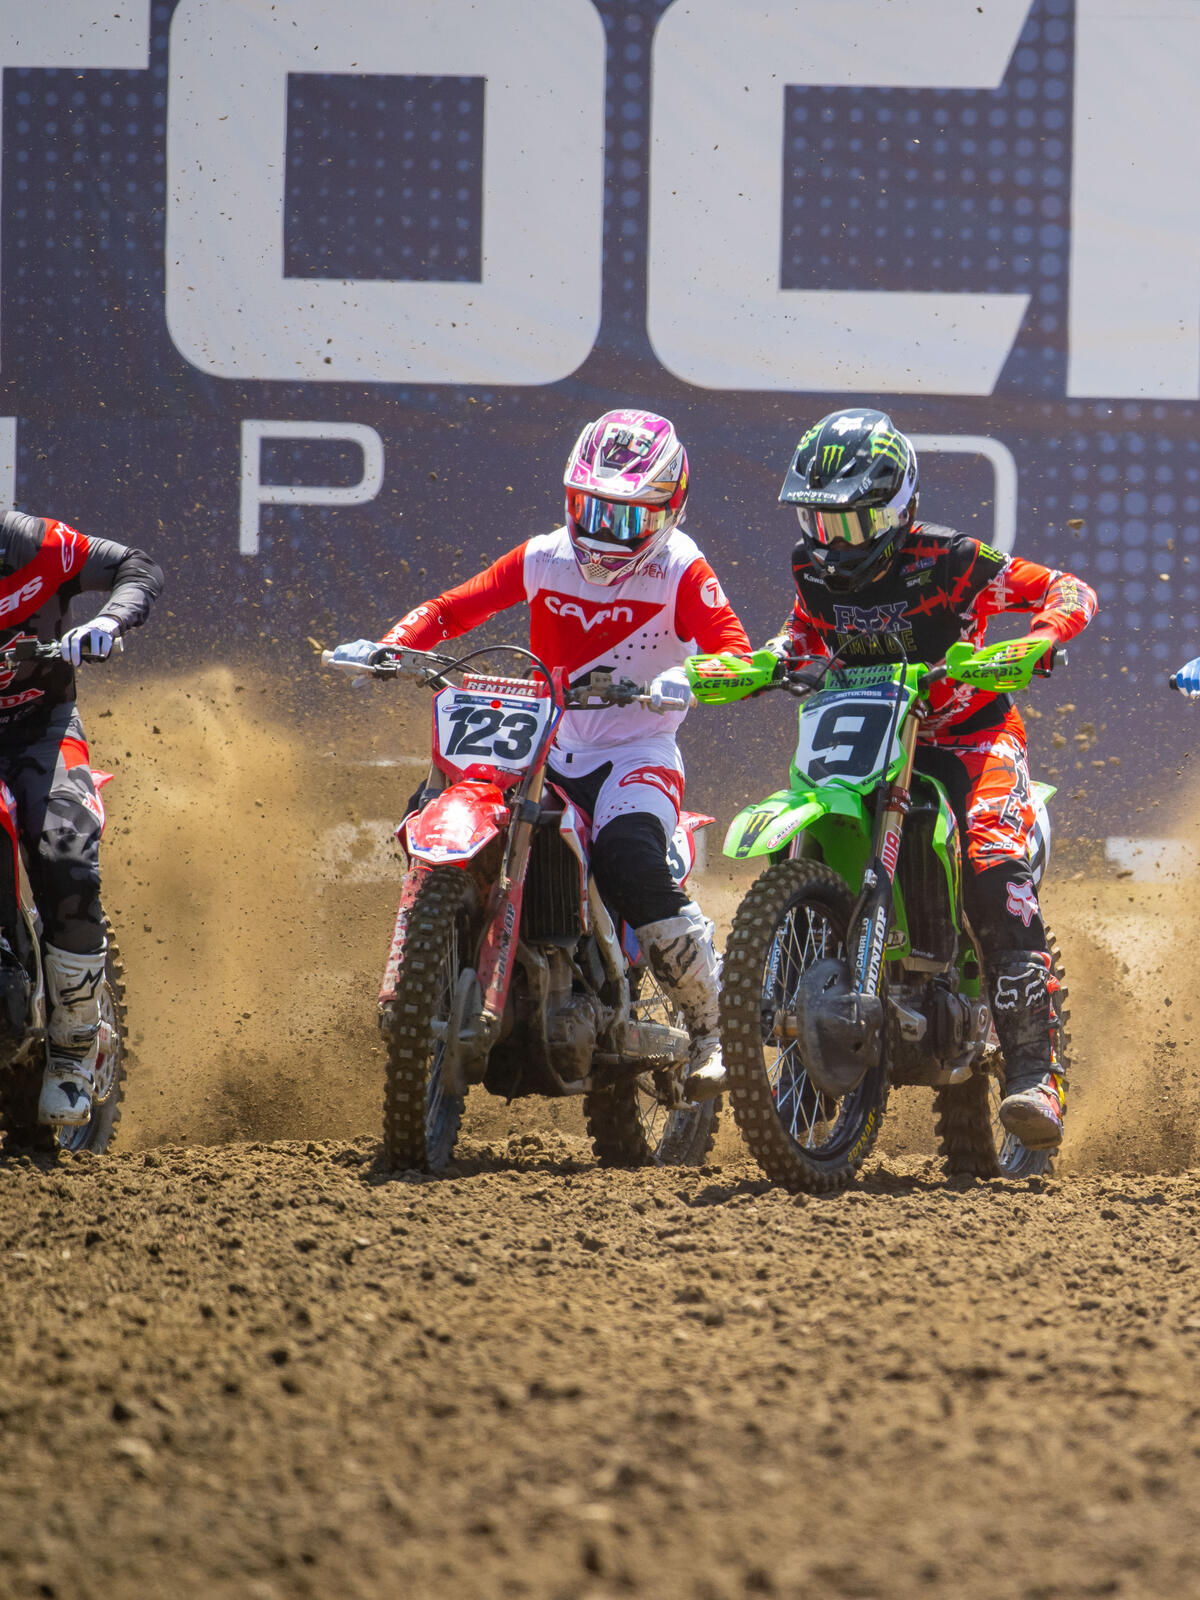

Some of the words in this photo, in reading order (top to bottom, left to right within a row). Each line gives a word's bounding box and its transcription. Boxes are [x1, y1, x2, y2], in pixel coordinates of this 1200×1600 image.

[858, 476, 873, 495] FOX
[787, 491, 837, 499] MONSTER
[961, 667, 1023, 678] ACERBIS
[466, 681, 536, 697] RENTHAL
[692, 678, 755, 690] ACERBIS
[445, 706, 538, 760] 123
[807, 703, 893, 781] 9
[867, 906, 887, 996] DUNLOP
